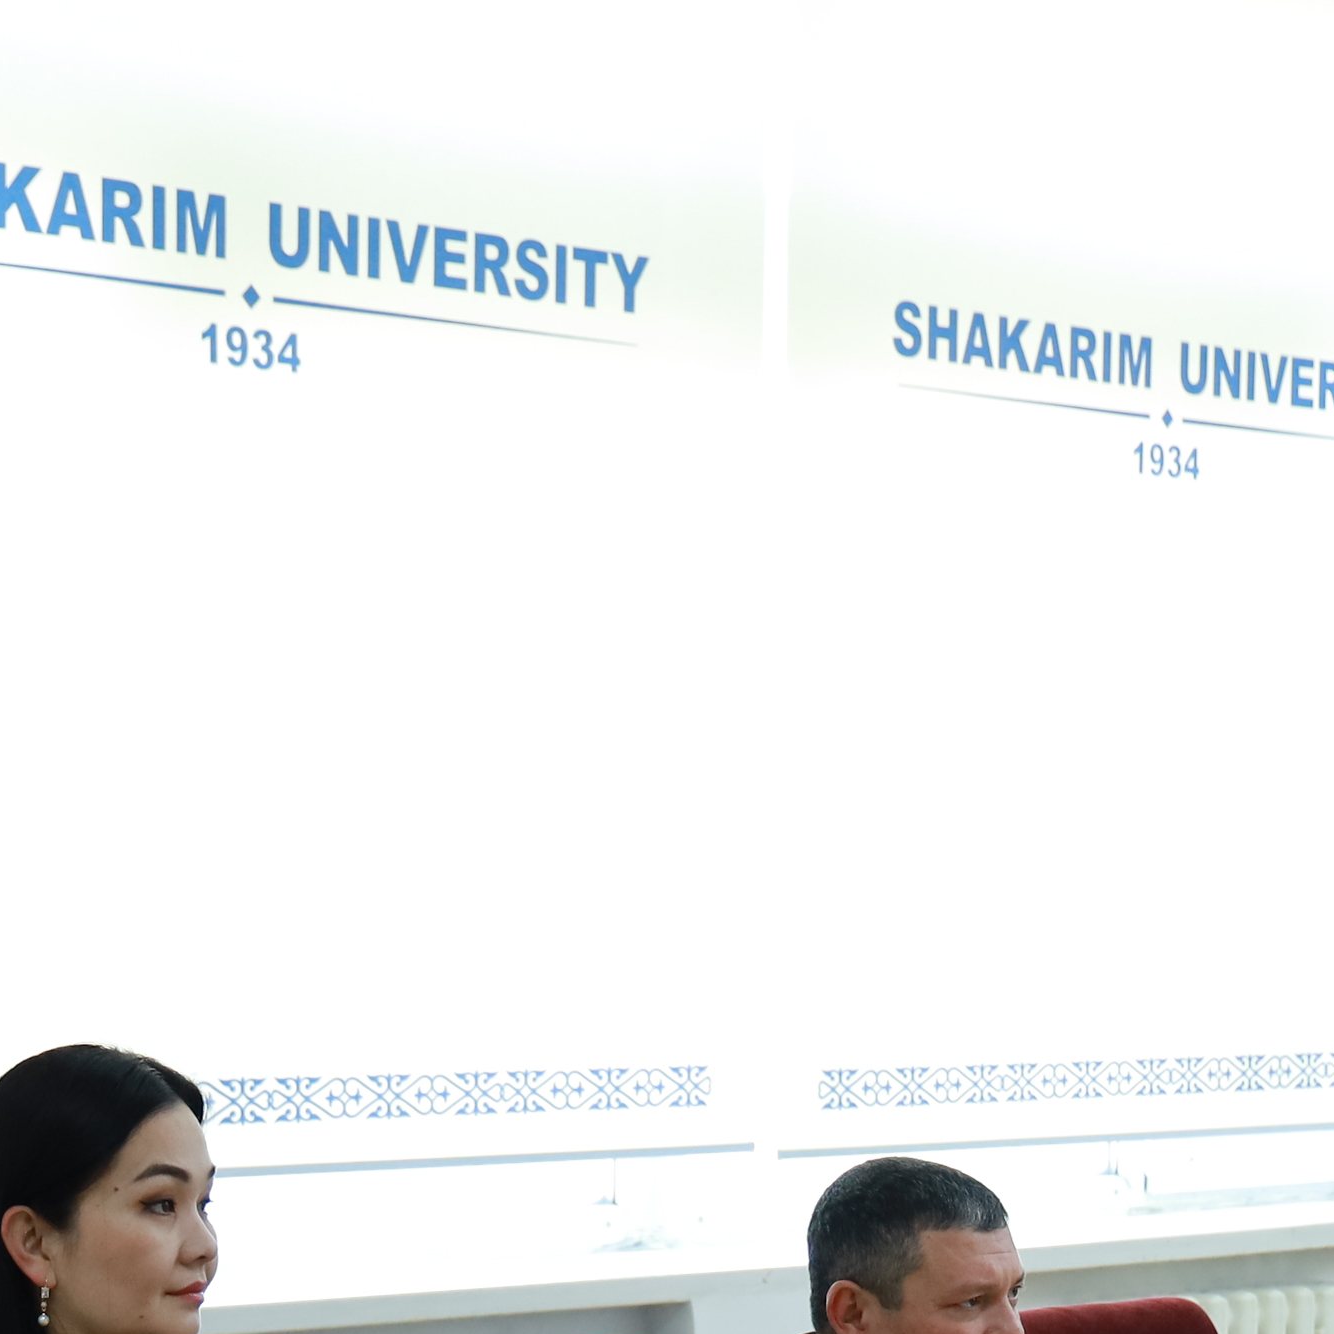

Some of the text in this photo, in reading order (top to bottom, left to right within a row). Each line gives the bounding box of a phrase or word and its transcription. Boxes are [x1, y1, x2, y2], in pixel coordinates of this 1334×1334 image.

[268, 202, 650, 313] UNIVERSITY
[200, 322, 301, 374] 1934
[892, 300, 1153, 389] SHAKARIM
[1133, 440, 1200, 480] 1934
